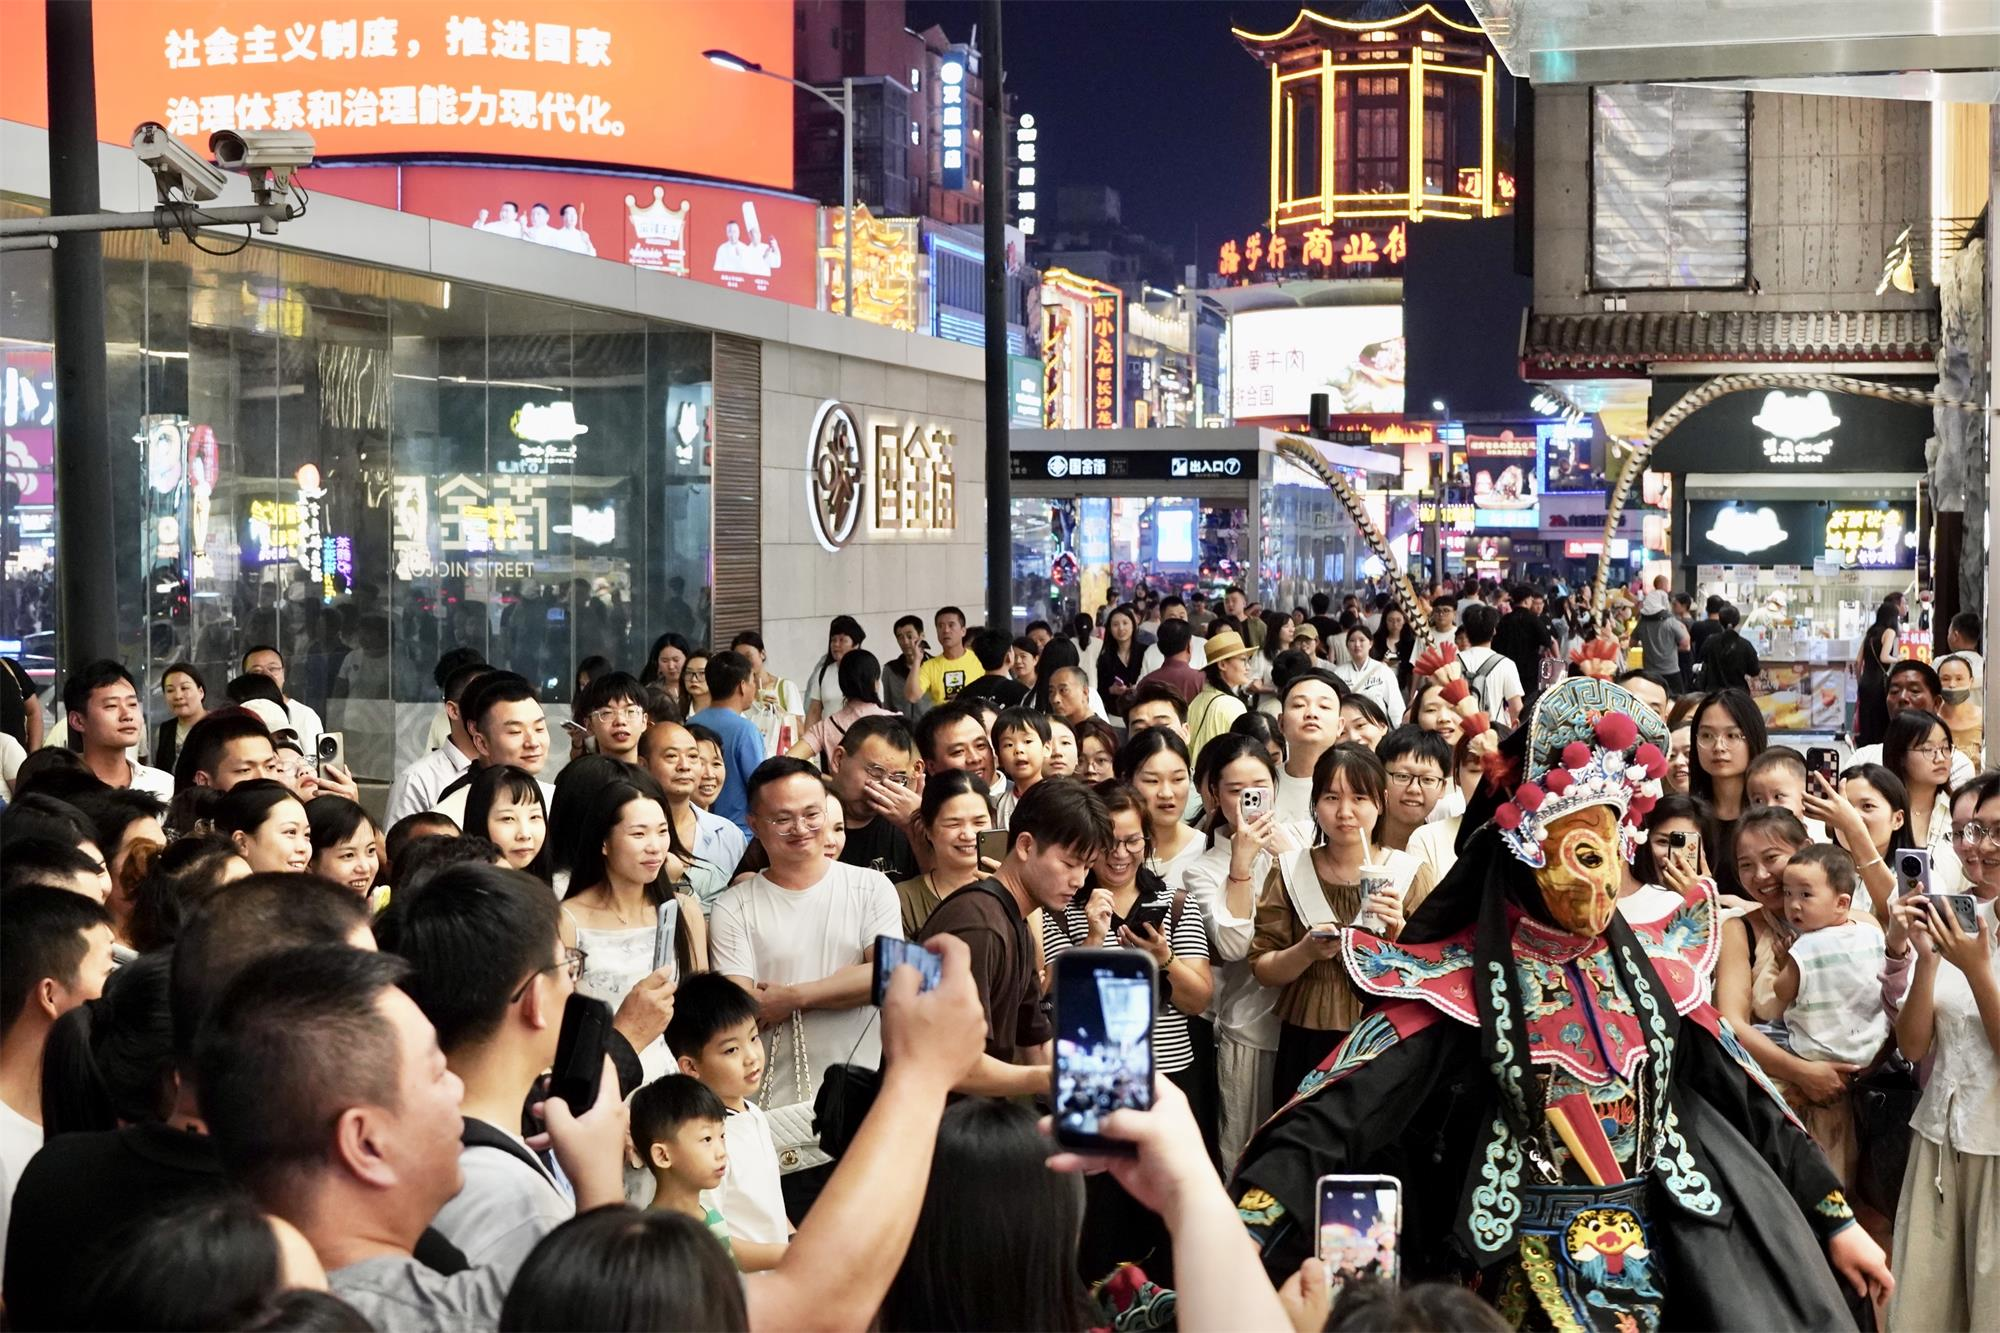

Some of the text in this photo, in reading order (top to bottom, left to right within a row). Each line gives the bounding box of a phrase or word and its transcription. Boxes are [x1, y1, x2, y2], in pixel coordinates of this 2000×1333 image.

[165, 16, 612, 69] 社会主义制度，推进国家
[165, 84, 626, 137] 治理体系和治理能力现代化。
[875, 424, 958, 529] 国金街
[1189, 459, 1224, 474] 出入口
[405, 562, 534, 578] OJOIN STREET
